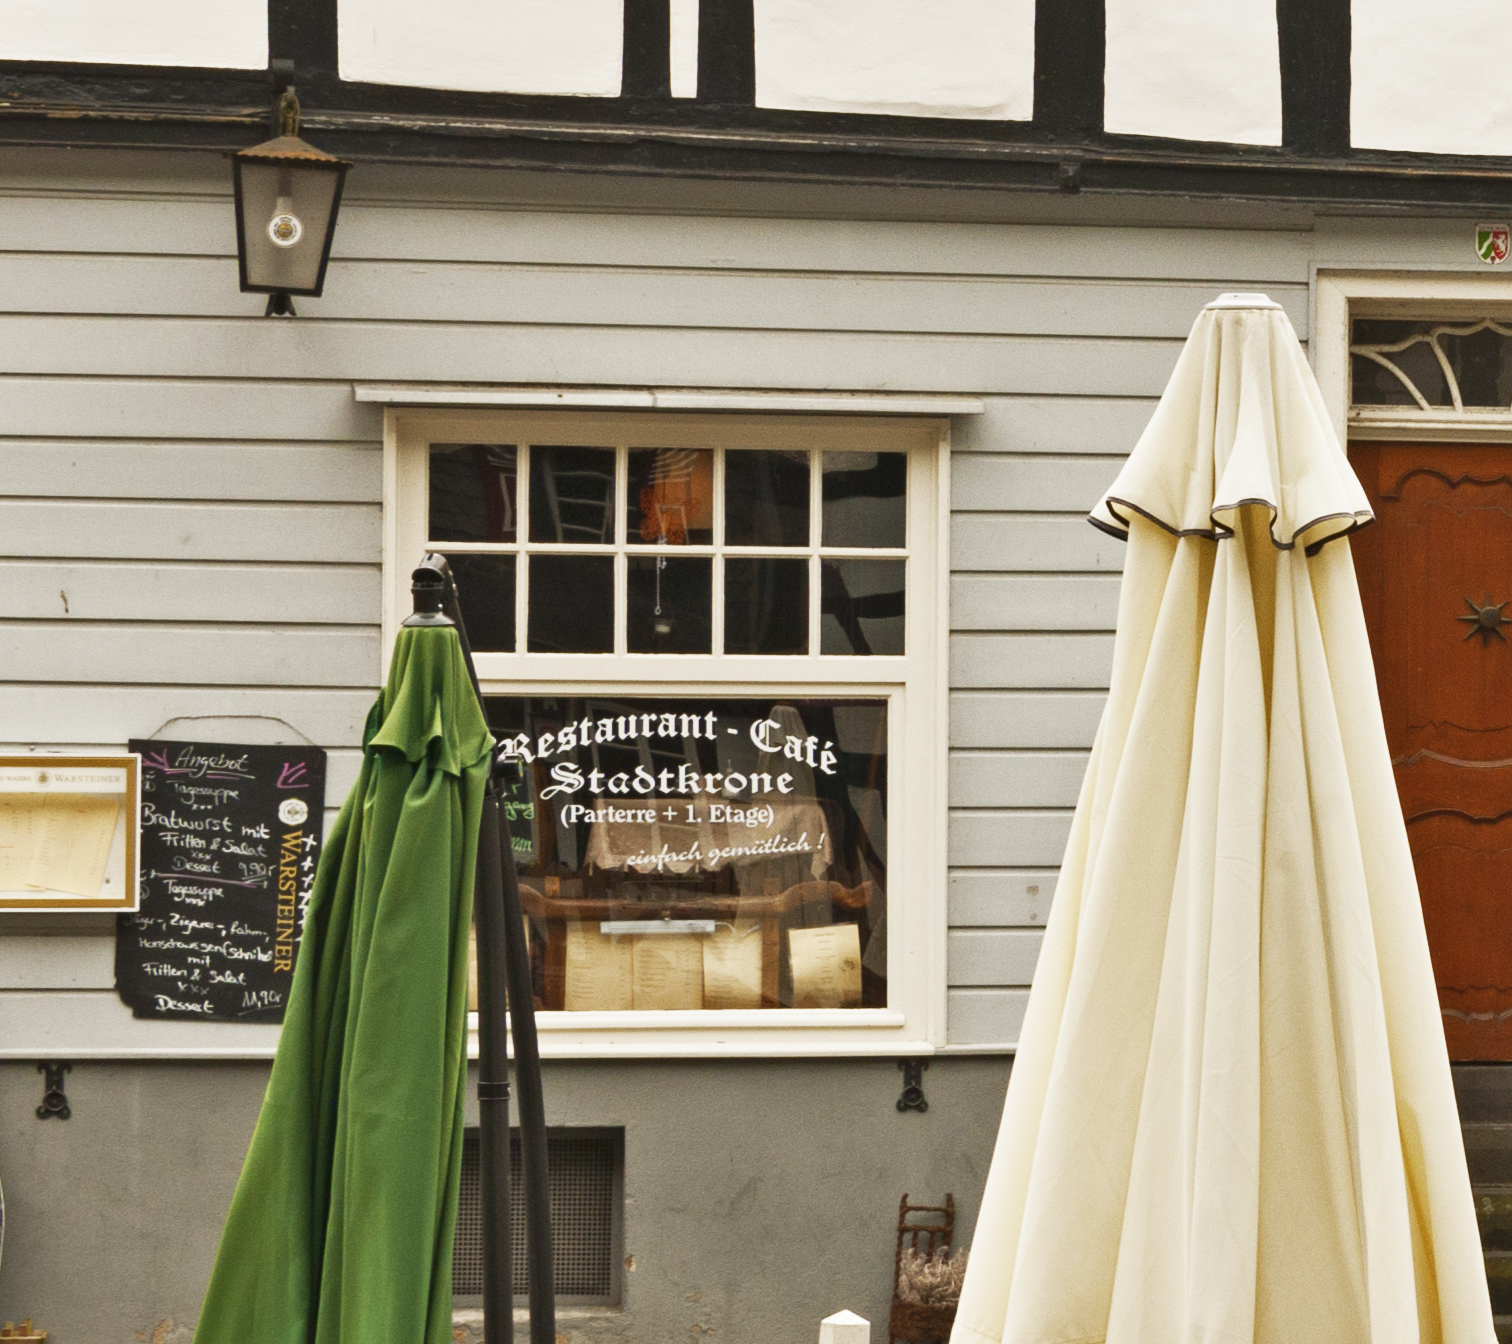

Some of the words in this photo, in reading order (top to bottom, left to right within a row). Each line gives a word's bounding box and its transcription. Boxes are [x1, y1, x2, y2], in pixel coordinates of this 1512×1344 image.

[498, 710, 718, 764] Restaurant
[750, 718, 837, 775] Café
[174, 746, 250, 778] Angebot
[540, 762, 794, 800] Stadtkrone
[141, 802, 233, 832] Bratwurst
[241, 823, 270, 839] mit
[560, 805, 656, 828] (Parterre
[662, 808, 678, 822] +
[685, 805, 702, 824] 1.
[709, 805, 775, 828] Etage)
[221, 839, 267, 857] Salat
[627, 840, 703, 871] einfach
[708, 832, 812, 867] gemütlich
[273, 829, 303, 973] WARSTEINER
[187, 955, 211, 968] mit
[209, 970, 247, 986] Salat
